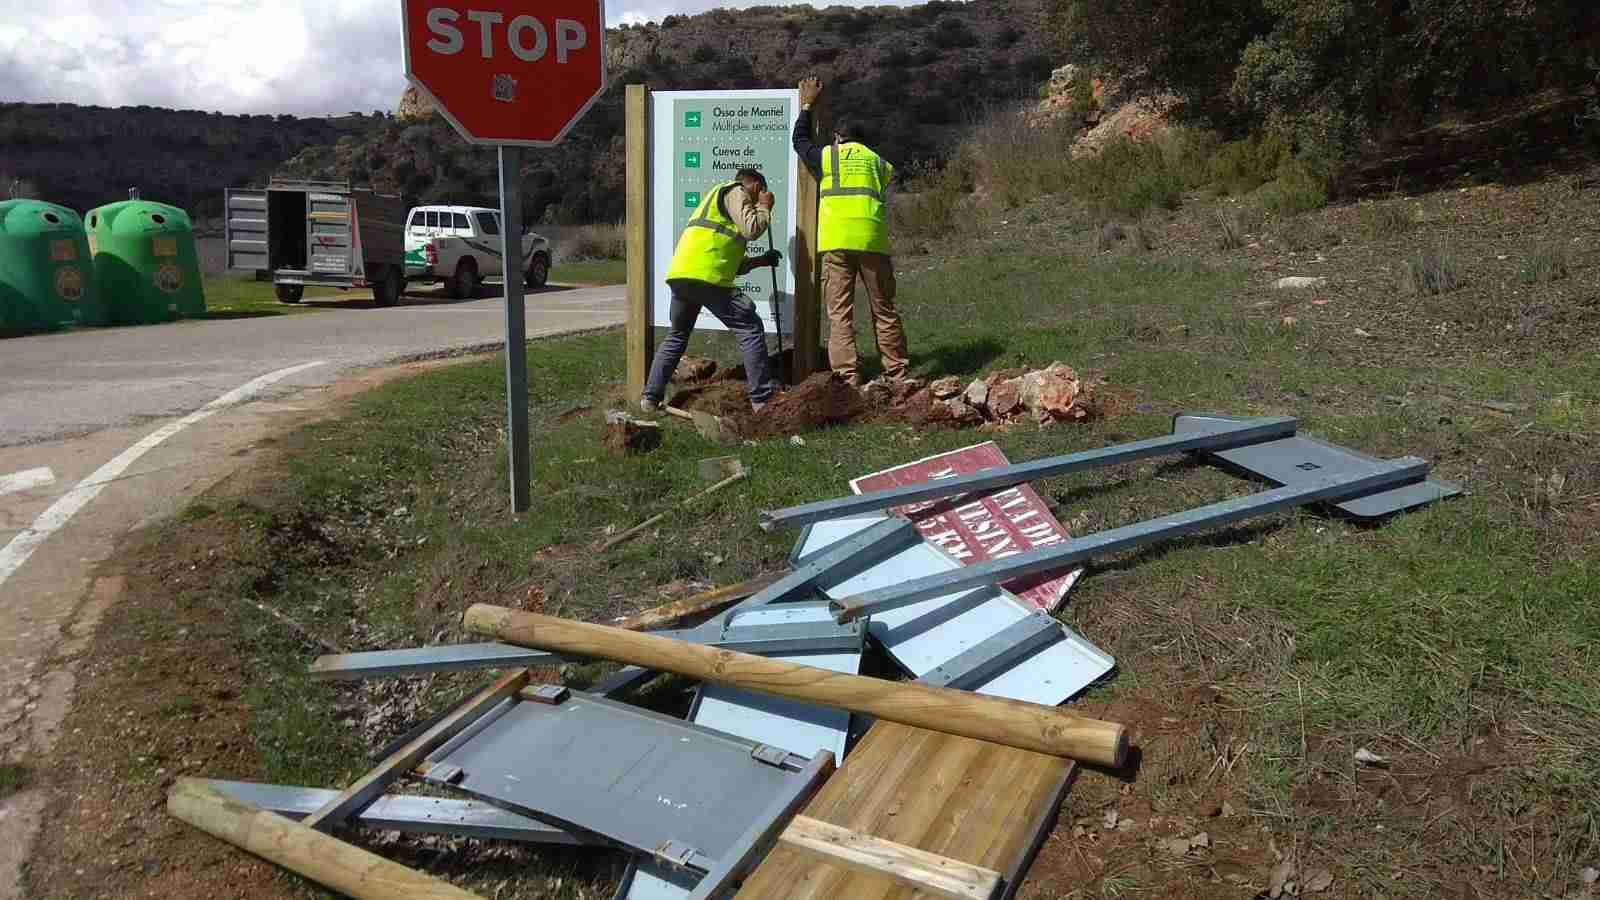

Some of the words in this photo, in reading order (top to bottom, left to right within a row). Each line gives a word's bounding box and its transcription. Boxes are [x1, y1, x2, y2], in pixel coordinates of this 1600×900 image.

[426, 7, 587, 64] STOP
[713, 107, 735, 117] Ossa
[737, 105, 749, 117] de
[751, 105, 785, 117] Montiel
[712, 146, 741, 156] Cueva
[743, 145, 756, 156] de
[712, 160, 763, 170] Montesinos
